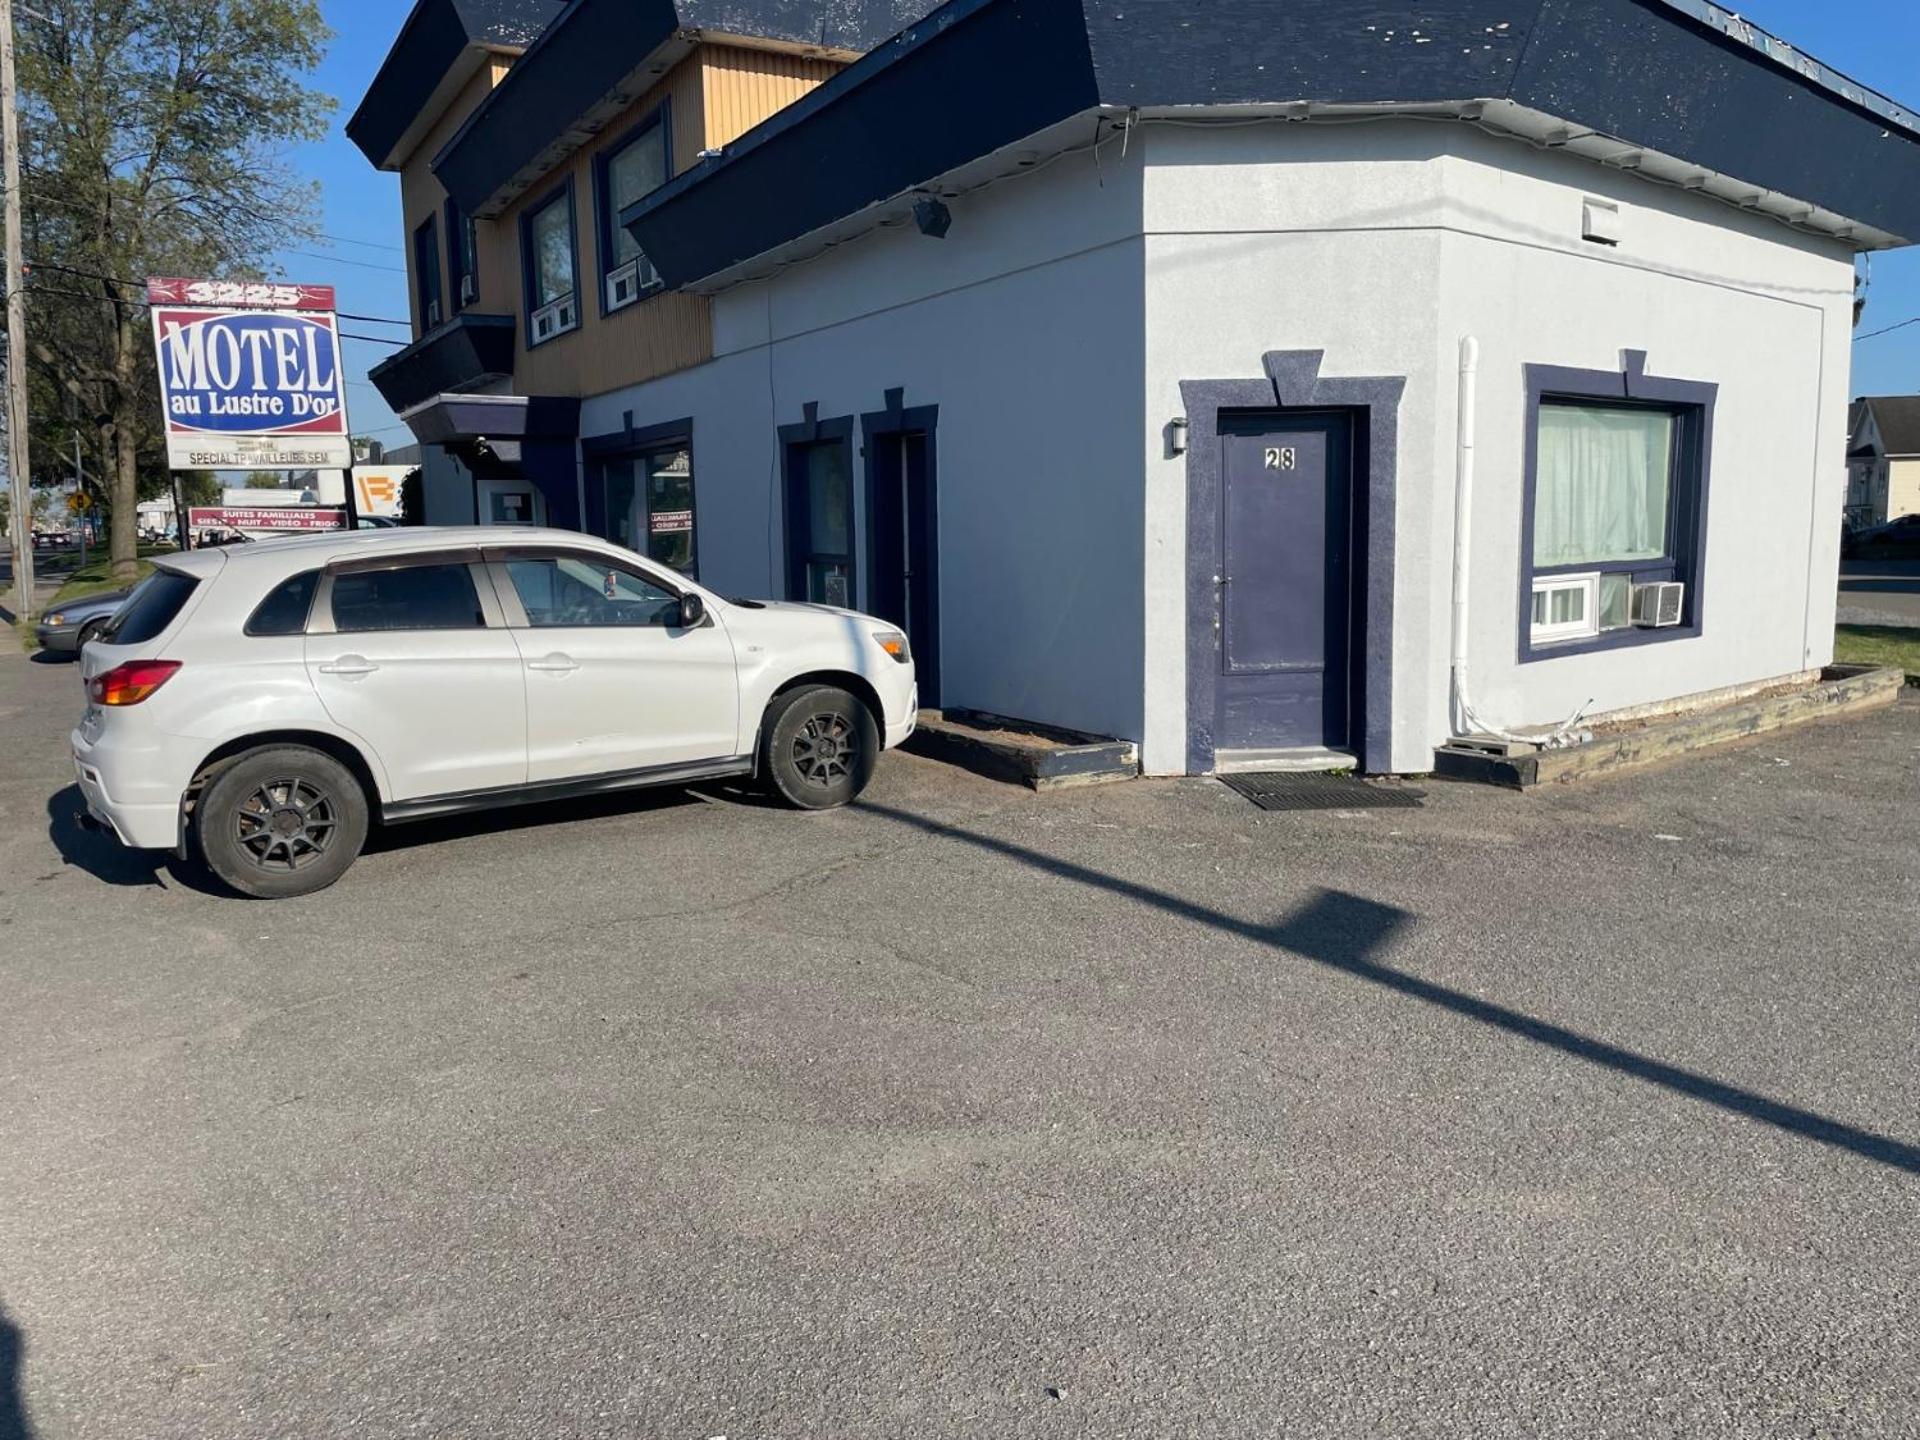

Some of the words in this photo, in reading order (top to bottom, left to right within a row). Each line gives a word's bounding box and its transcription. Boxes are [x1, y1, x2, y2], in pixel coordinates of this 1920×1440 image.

[186, 282, 302, 306] 3225
[165, 321, 334, 392] MOTEL
[171, 394, 201, 415] au
[209, 391, 284, 416] Lustre
[291, 393, 336, 416] D'or
[190, 452, 233, 466] SPECIAL
[1266, 448, 1294, 470] 28
[222, 510, 255, 519] SUITES
